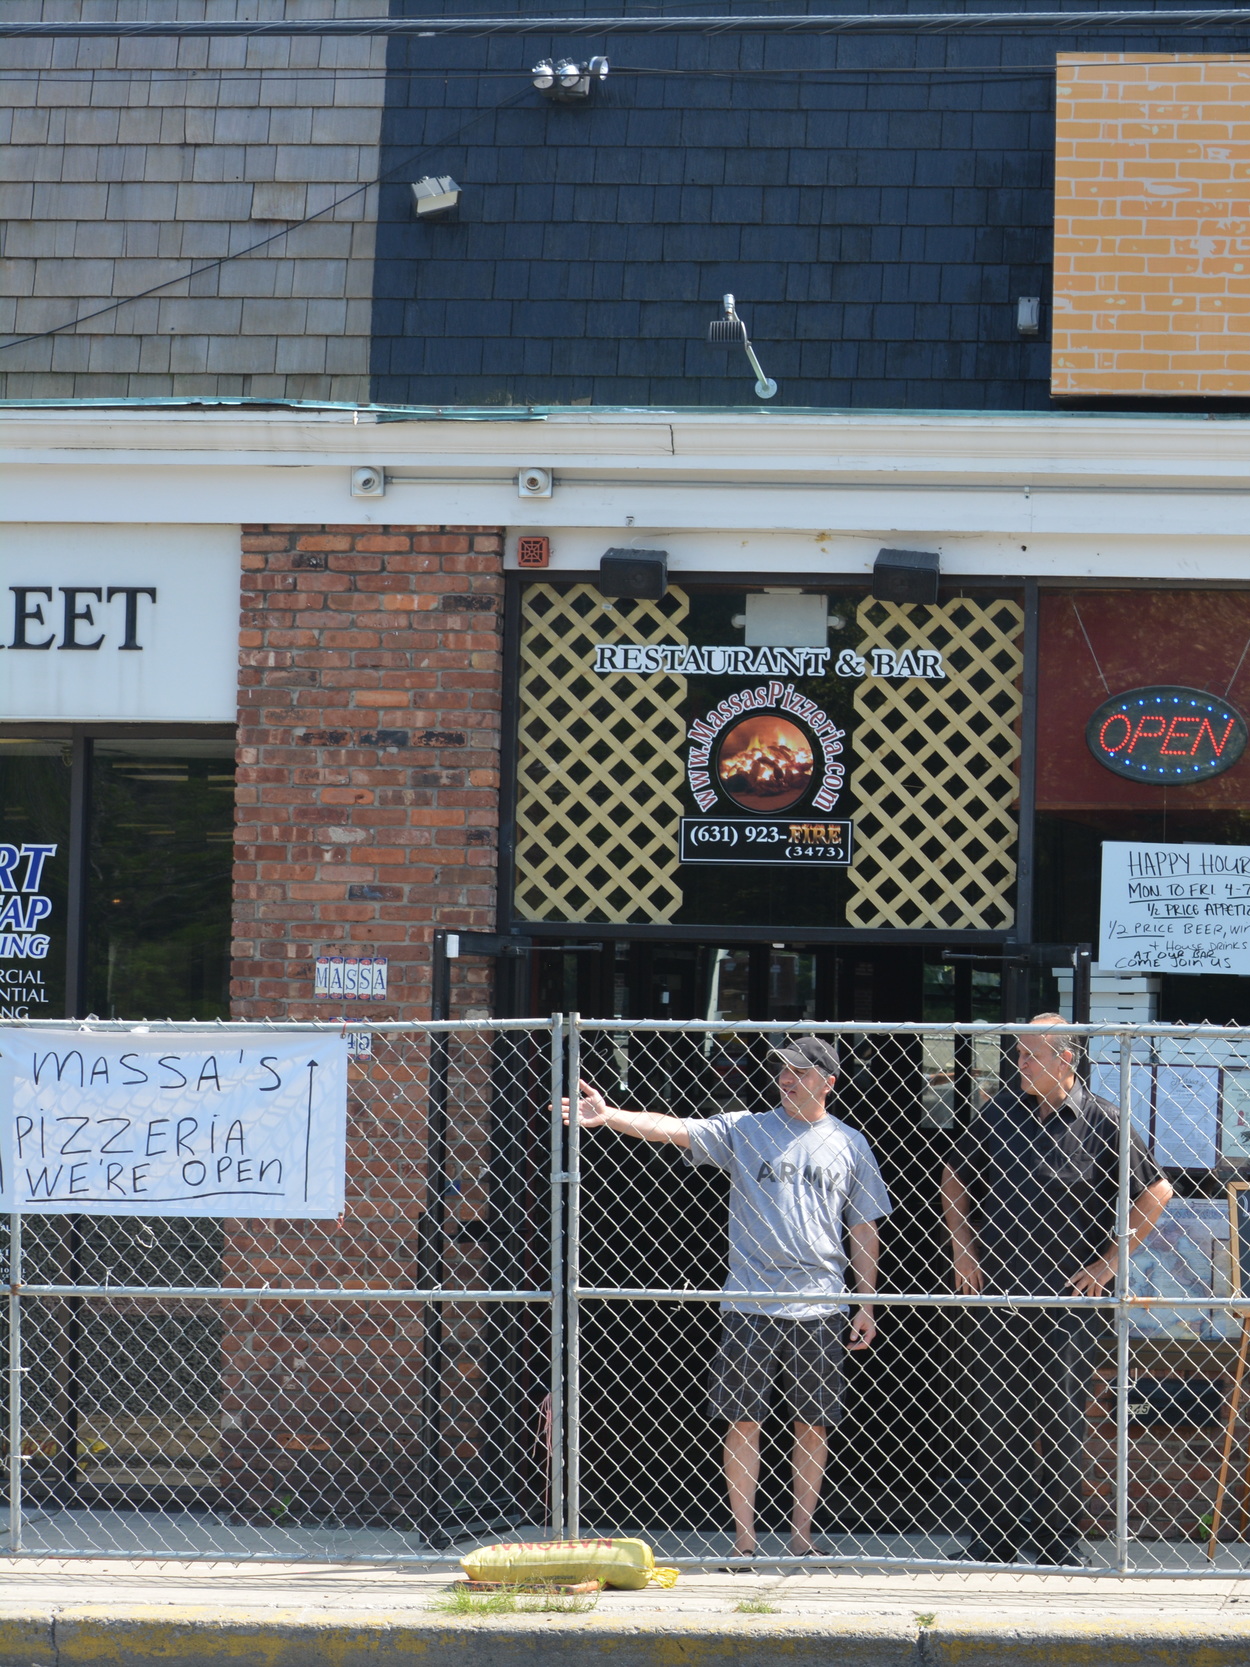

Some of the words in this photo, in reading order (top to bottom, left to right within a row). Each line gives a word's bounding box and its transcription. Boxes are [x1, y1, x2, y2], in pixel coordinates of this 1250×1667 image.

[0, 586, 157, 651] EET
[594, 644, 831, 676] RESTAURANT
[836, 649, 866, 677] &
[872, 649, 946, 679] BAR
[687, 680, 846, 813] www.MassasPizzeria.com
[1099, 713, 1235, 757] OPEN
[690, 825, 739, 847] (631)
[744, 824, 842, 845] 923-FIRE
[785, 846, 845, 860] (3473)
[1128, 851, 1190, 876] HAPPY
[1128, 883, 1163, 898] MON.
[1167, 884, 1185, 897] TO
[0, 894, 53, 931] AP
[1165, 904, 1200, 916] PRICE
[1134, 923, 1174, 934] PRICE
[1133, 951, 1151, 959] AT
[1157, 951, 1184, 961] OUR
[1192, 950, 1217, 959] BAR
[315, 966, 386, 990] MASSA
[25, 1159, 151, 1196] WE'RE
[756, 1160, 841, 1192] ARMY
